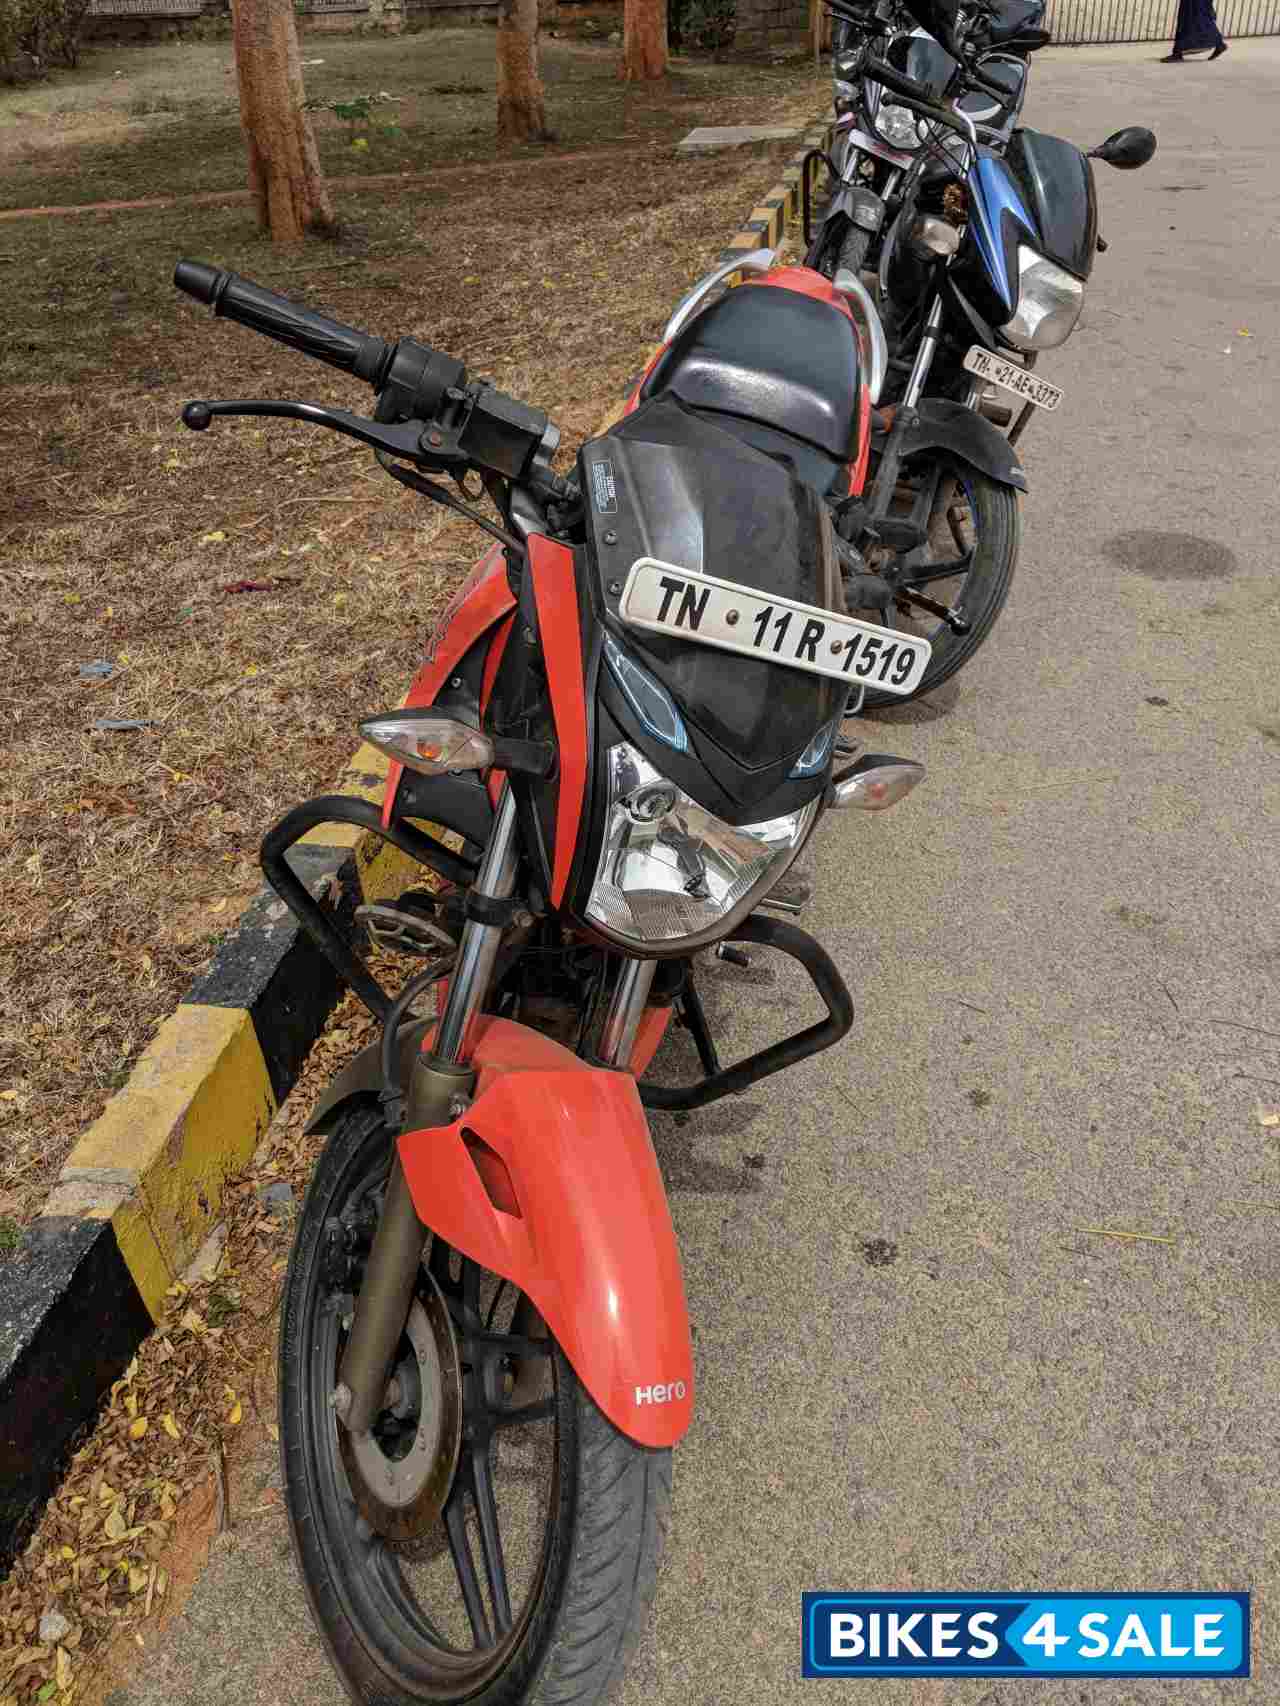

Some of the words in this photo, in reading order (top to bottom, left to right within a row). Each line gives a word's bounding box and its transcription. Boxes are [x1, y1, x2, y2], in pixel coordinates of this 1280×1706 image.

[657, 576, 711, 630] TN
[753, 606, 793, 652] 11
[795, 618, 825, 662] R
[842, 633, 915, 685] 1519
[635, 1381, 686, 1405] Hero
